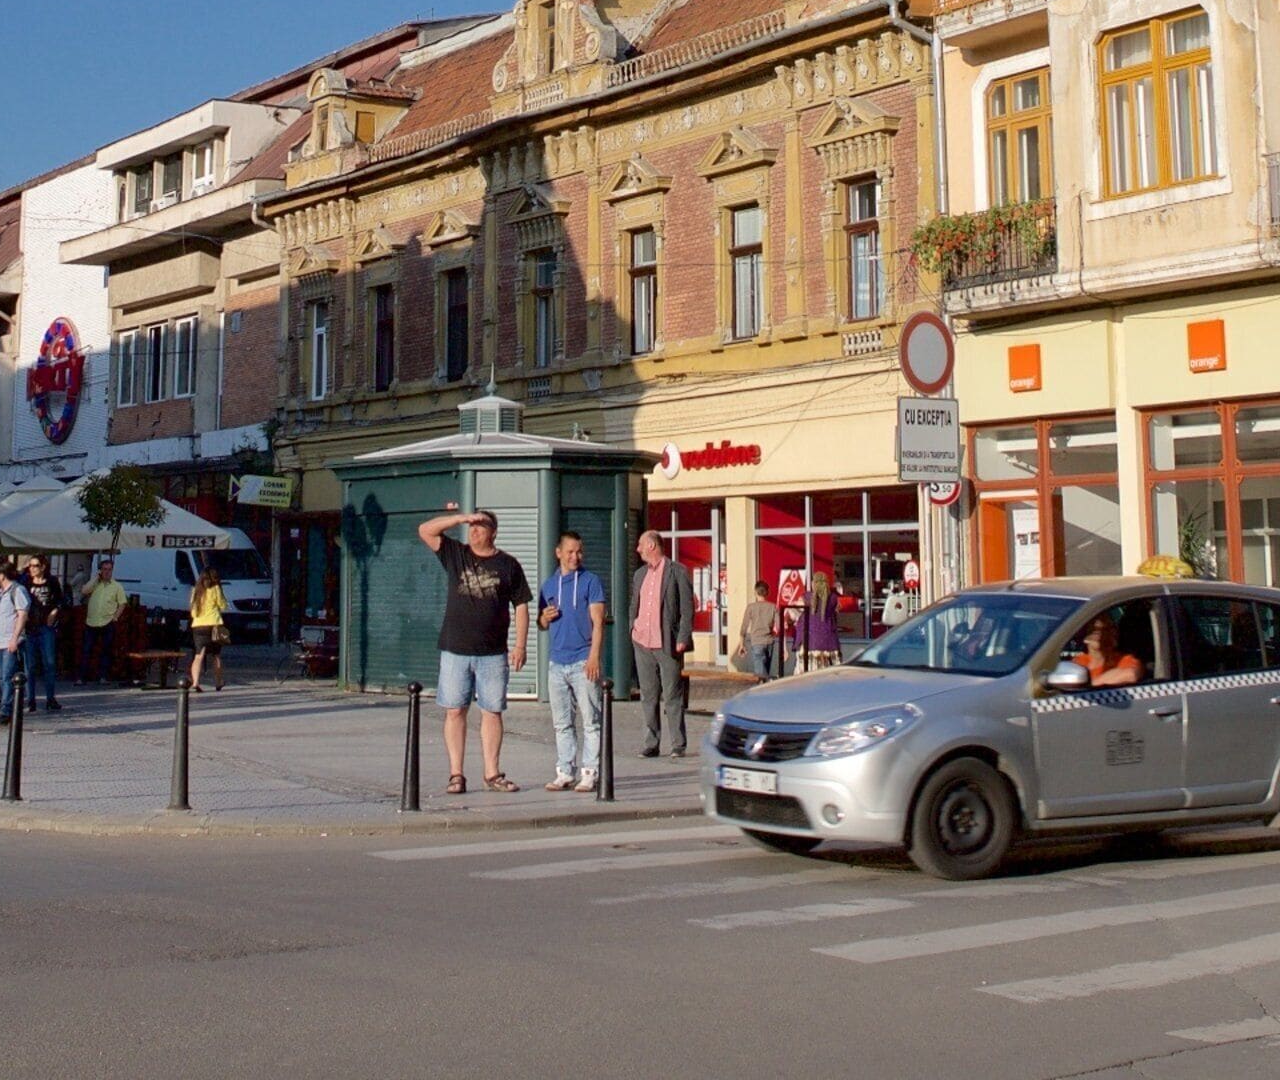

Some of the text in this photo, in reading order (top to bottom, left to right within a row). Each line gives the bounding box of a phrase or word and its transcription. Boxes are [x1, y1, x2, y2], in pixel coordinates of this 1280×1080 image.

[1190, 357, 1219, 369] orange
[905, 409, 915, 425] CU
[680, 440, 761, 471] vodafone
